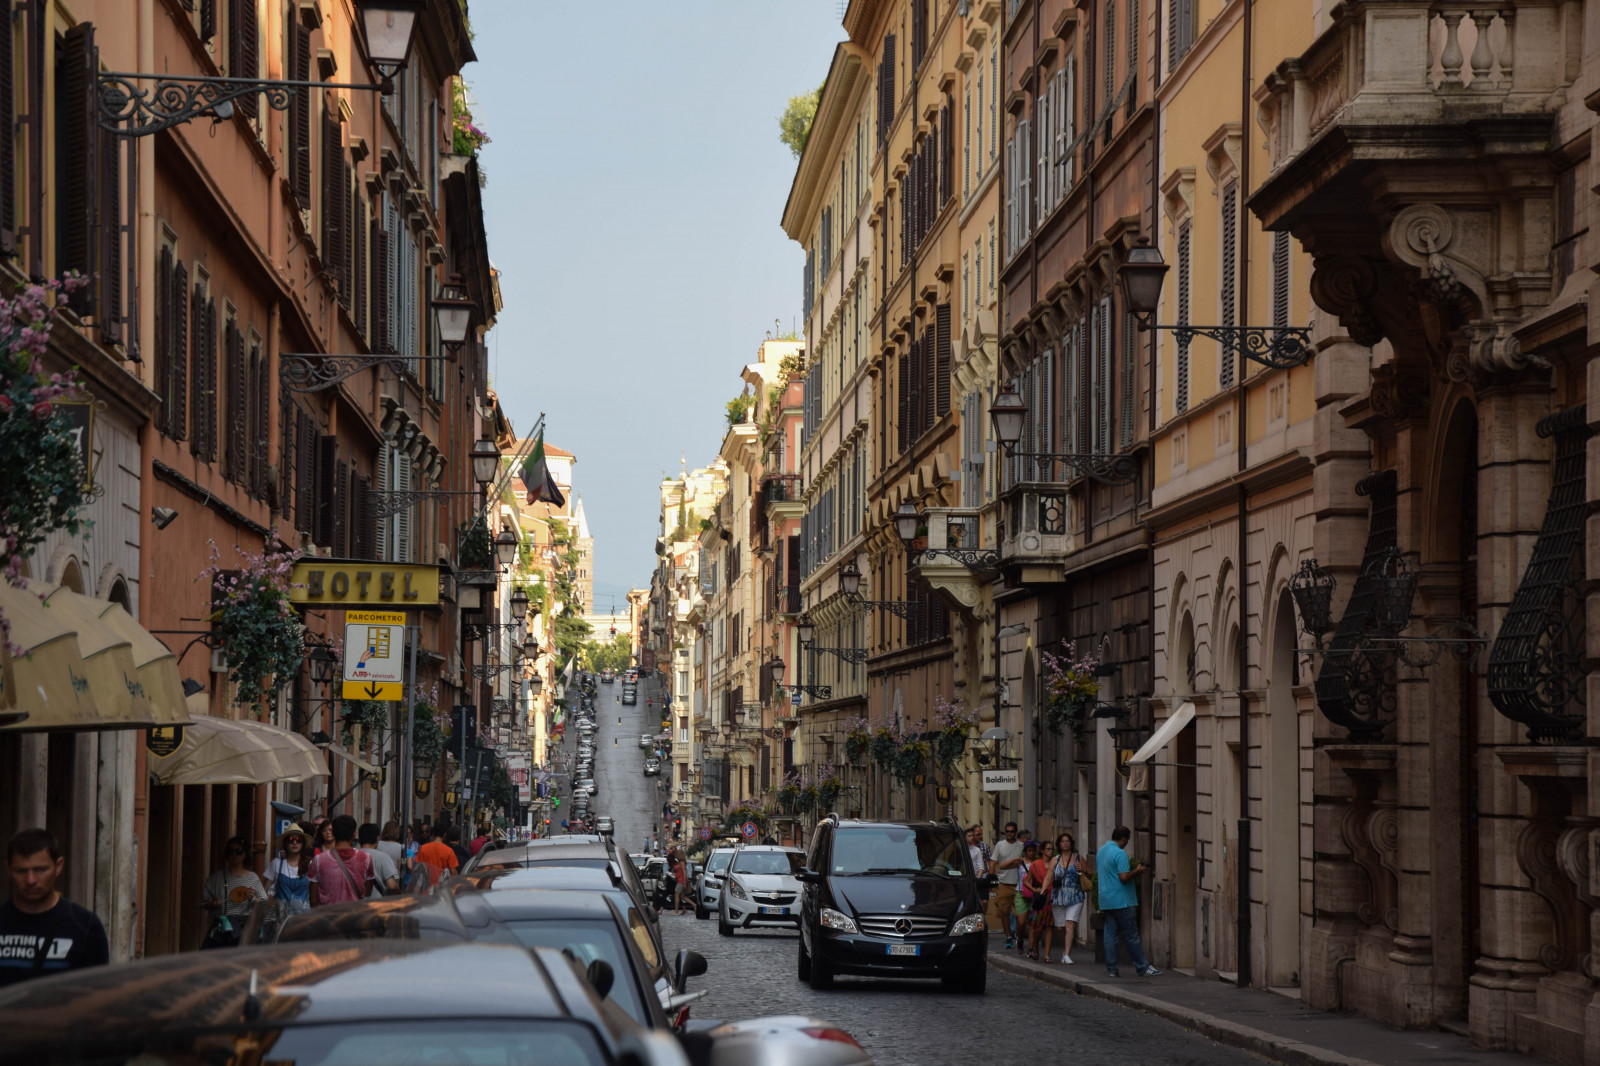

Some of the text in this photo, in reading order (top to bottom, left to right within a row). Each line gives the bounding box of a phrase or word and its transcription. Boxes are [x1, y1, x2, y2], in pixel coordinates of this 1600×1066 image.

[308, 570, 418, 597] HOTEL
[348, 613, 403, 622] PARCOMETRO
[985, 775, 1016, 784] Baldinini
[281, 819, 292, 834] P
